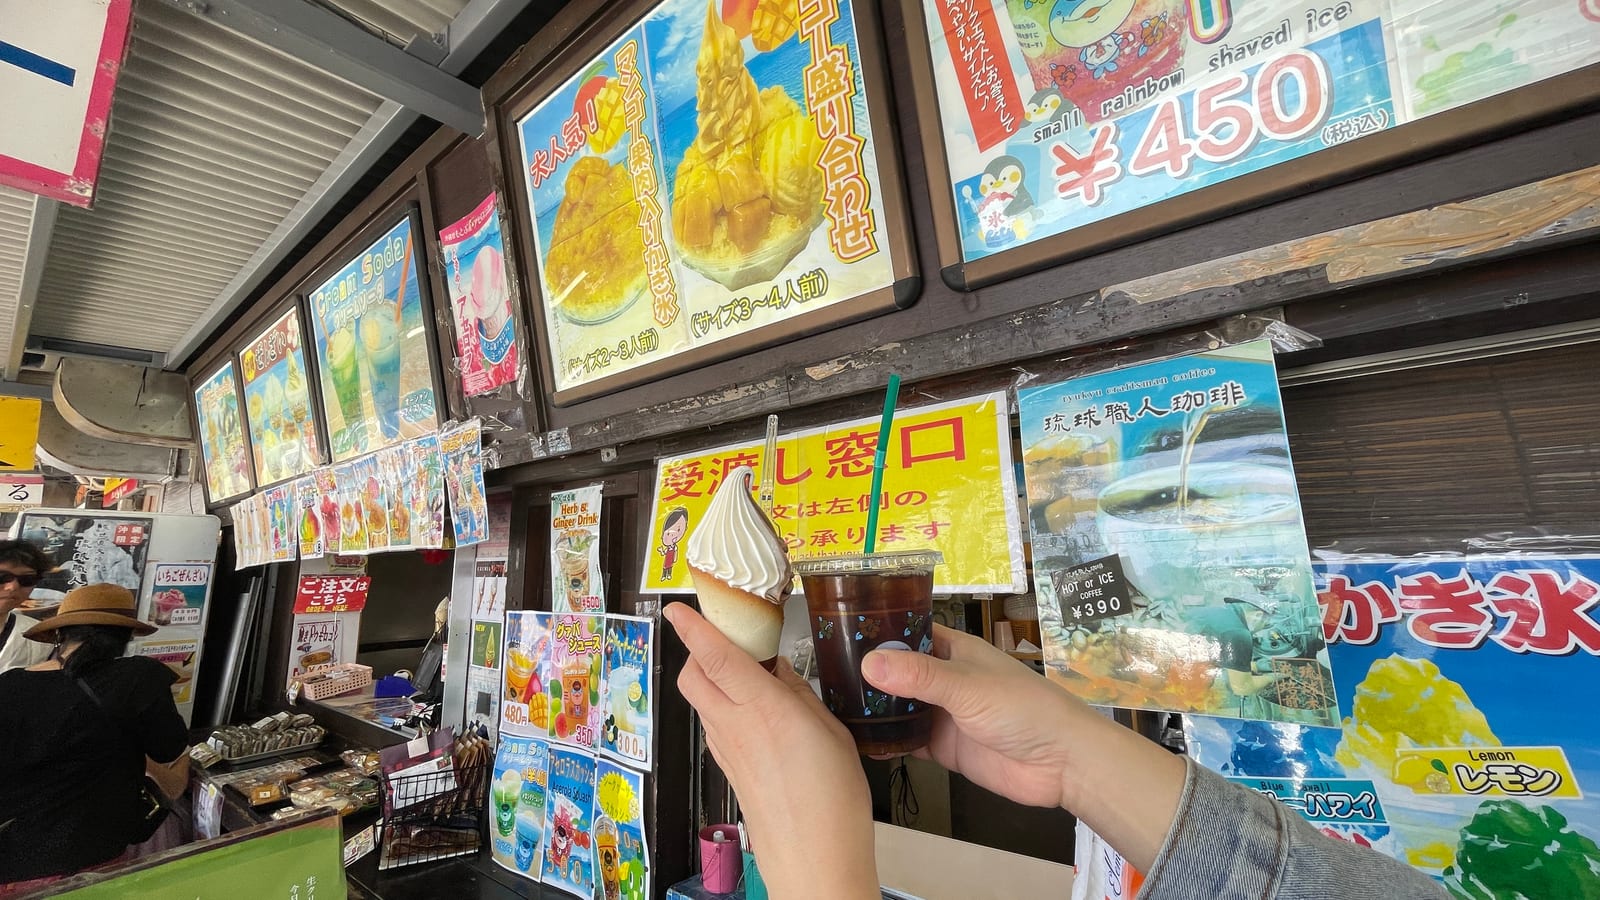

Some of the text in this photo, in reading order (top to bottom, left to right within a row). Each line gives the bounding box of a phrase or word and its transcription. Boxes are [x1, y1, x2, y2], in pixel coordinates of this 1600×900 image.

[1033, 108, 1082, 143] small
[1101, 69, 1185, 116] rainbow
[1208, 18, 1292, 72] shaved
[1305, 1, 1352, 32] ice
[1050, 50, 1328, 206] ¥450
[1321, 109, 1389, 146] (税込)
[614, 40, 680, 329] マンゴー果肉入りかき氷
[315, 271, 358, 318] Cream
[361, 236, 405, 284] Soda
[1173, 367, 1216, 381] coffee
[1044, 381, 1246, 432] 琉球職人珈琲
[561, 503, 578, 515] Herb
[553, 512, 598, 530] Ginger Drink
[158, 569, 206, 582] いちごぜんざい
[301, 577, 368, 594] ご注文は
[1062, 572, 1115, 595] HOT or ICE
[311, 594, 346, 605] こちら
[1080, 588, 1103, 600] COFFEE
[1071, 597, 1121, 619] ¥390
[1317, 568, 1600, 655] かき氷
[568, 635, 601, 654] ジュース
[505, 704, 528, 726] 480円
[576, 725, 593, 746] 350
[1468, 750, 1515, 761] Lemon
[551, 782, 572, 798] Acerola
[1260, 781, 1284, 791] Blue
[1454, 763, 1562, 797] レモン
